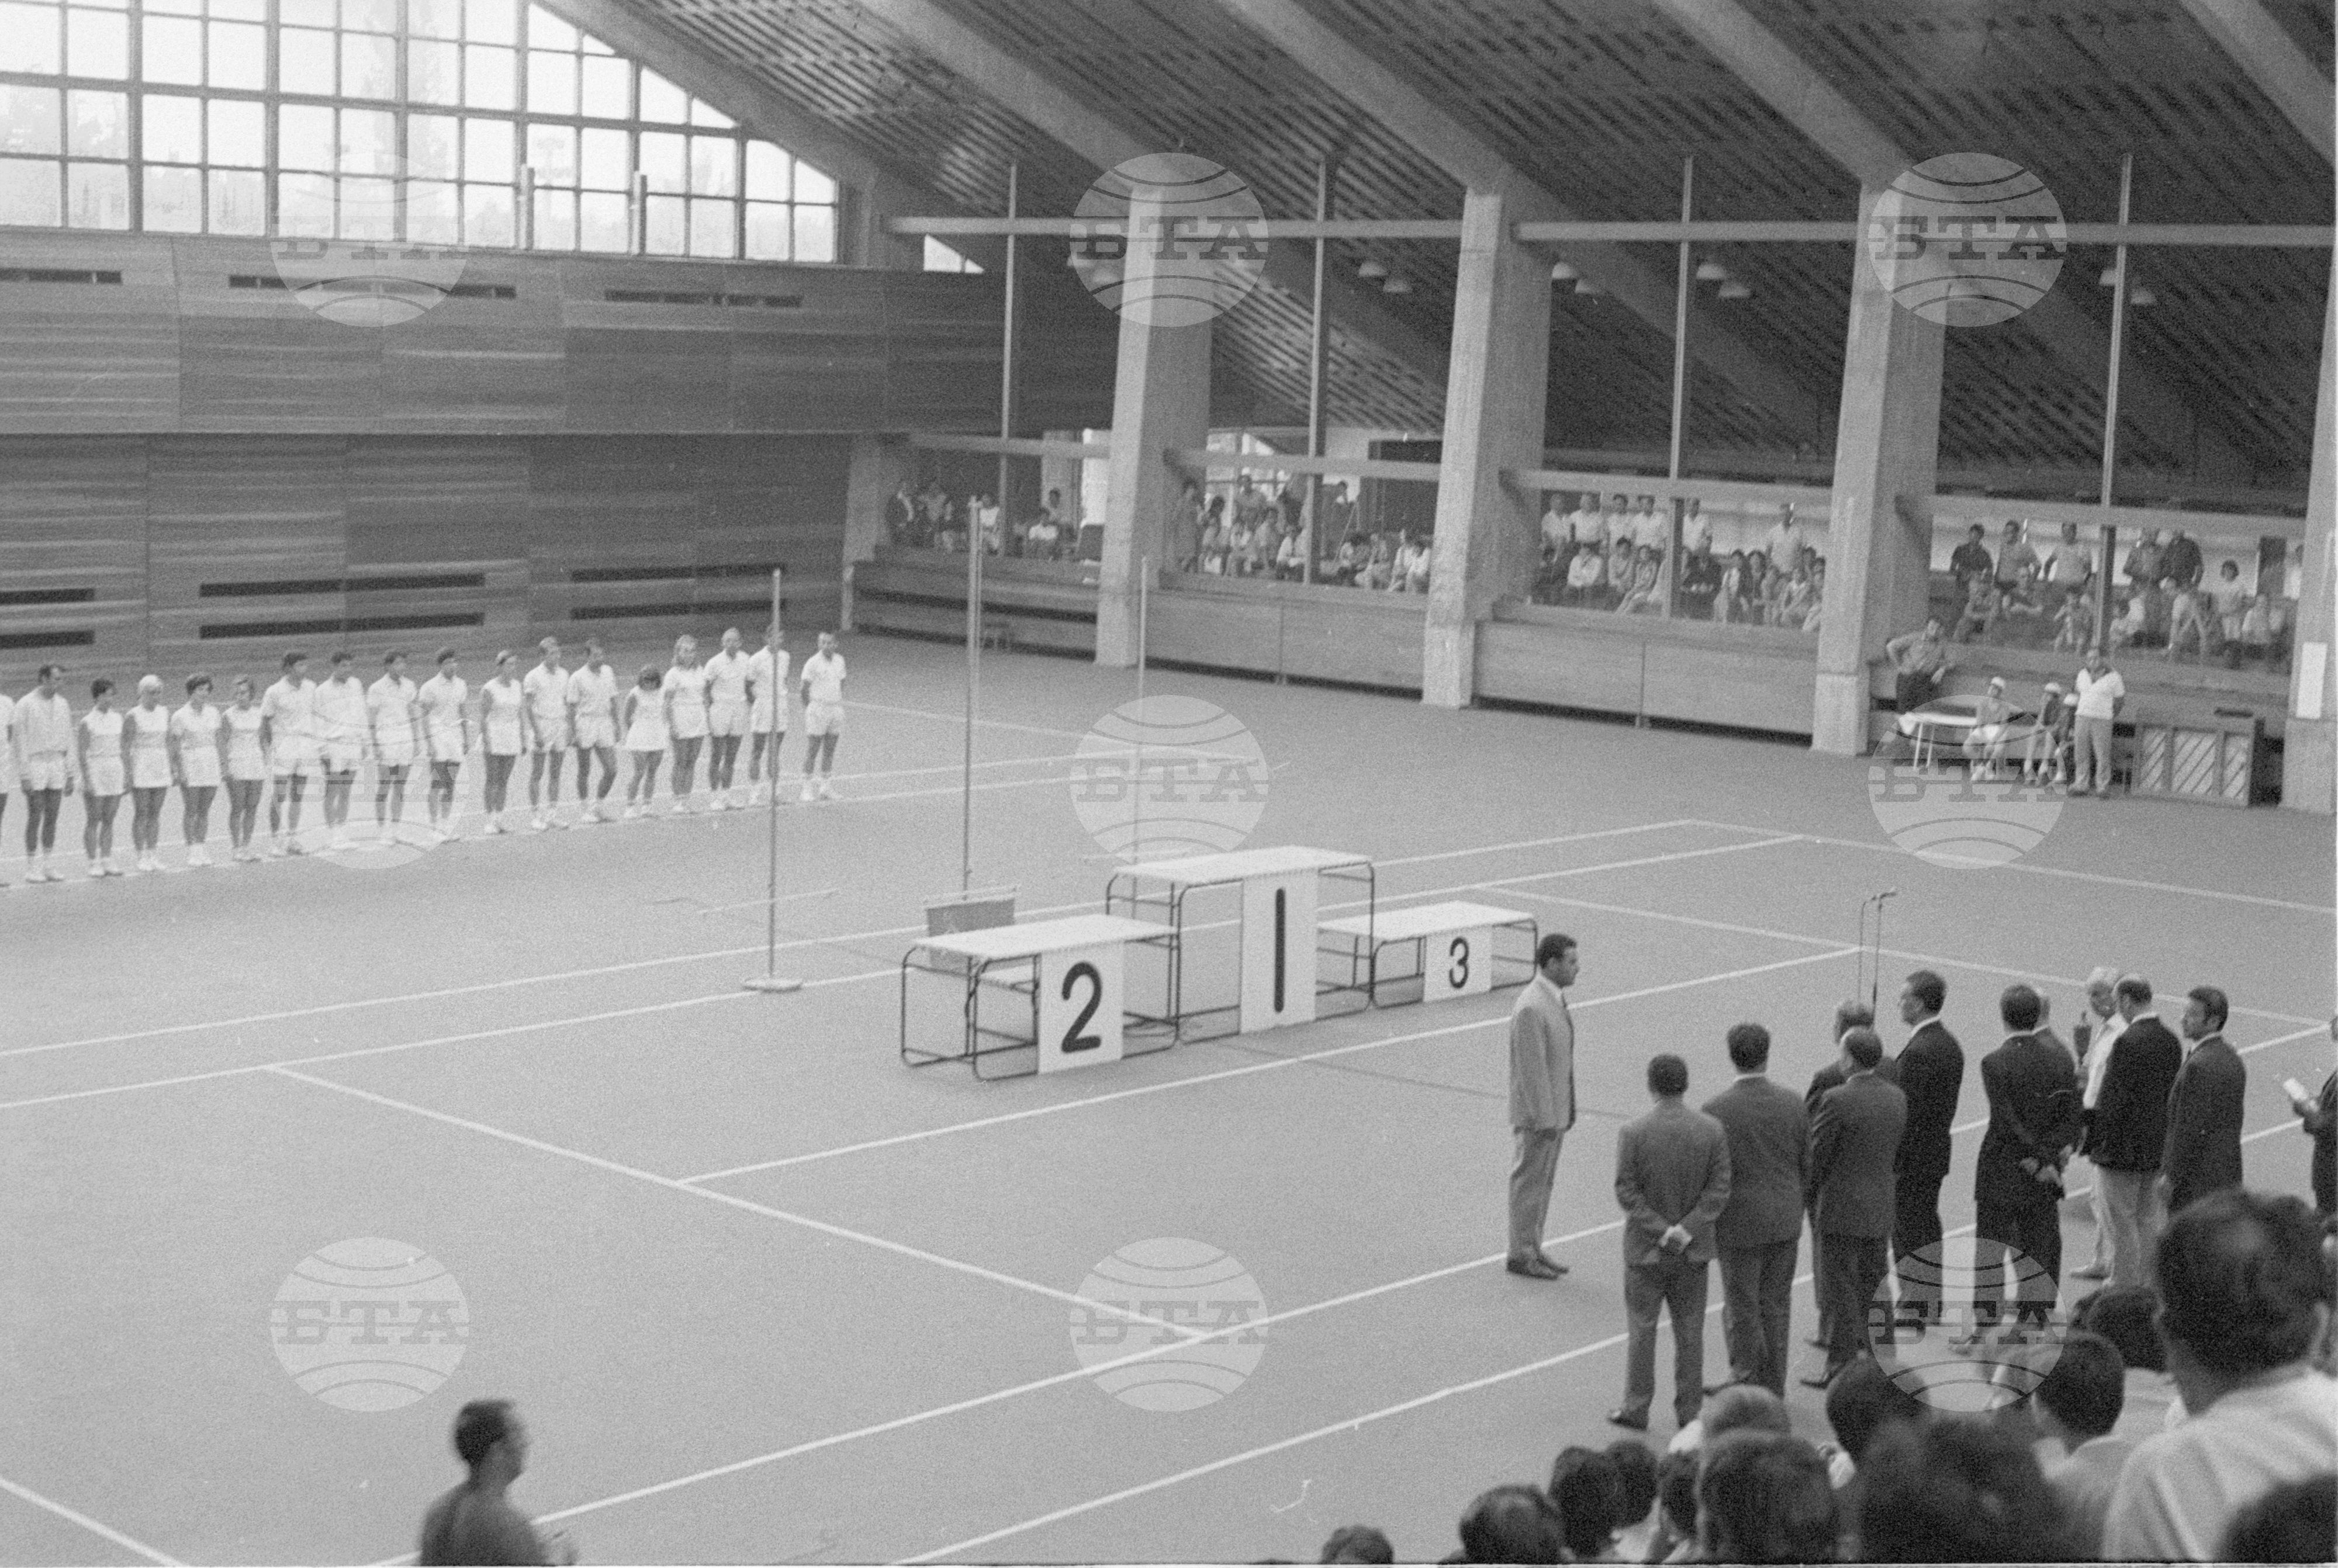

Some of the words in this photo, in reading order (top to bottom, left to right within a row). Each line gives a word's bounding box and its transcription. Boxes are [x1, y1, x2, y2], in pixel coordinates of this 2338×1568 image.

[1274, 887, 1287, 1014] 1
[1448, 936, 1470, 989] 3
[1061, 961, 1103, 1053] 2
